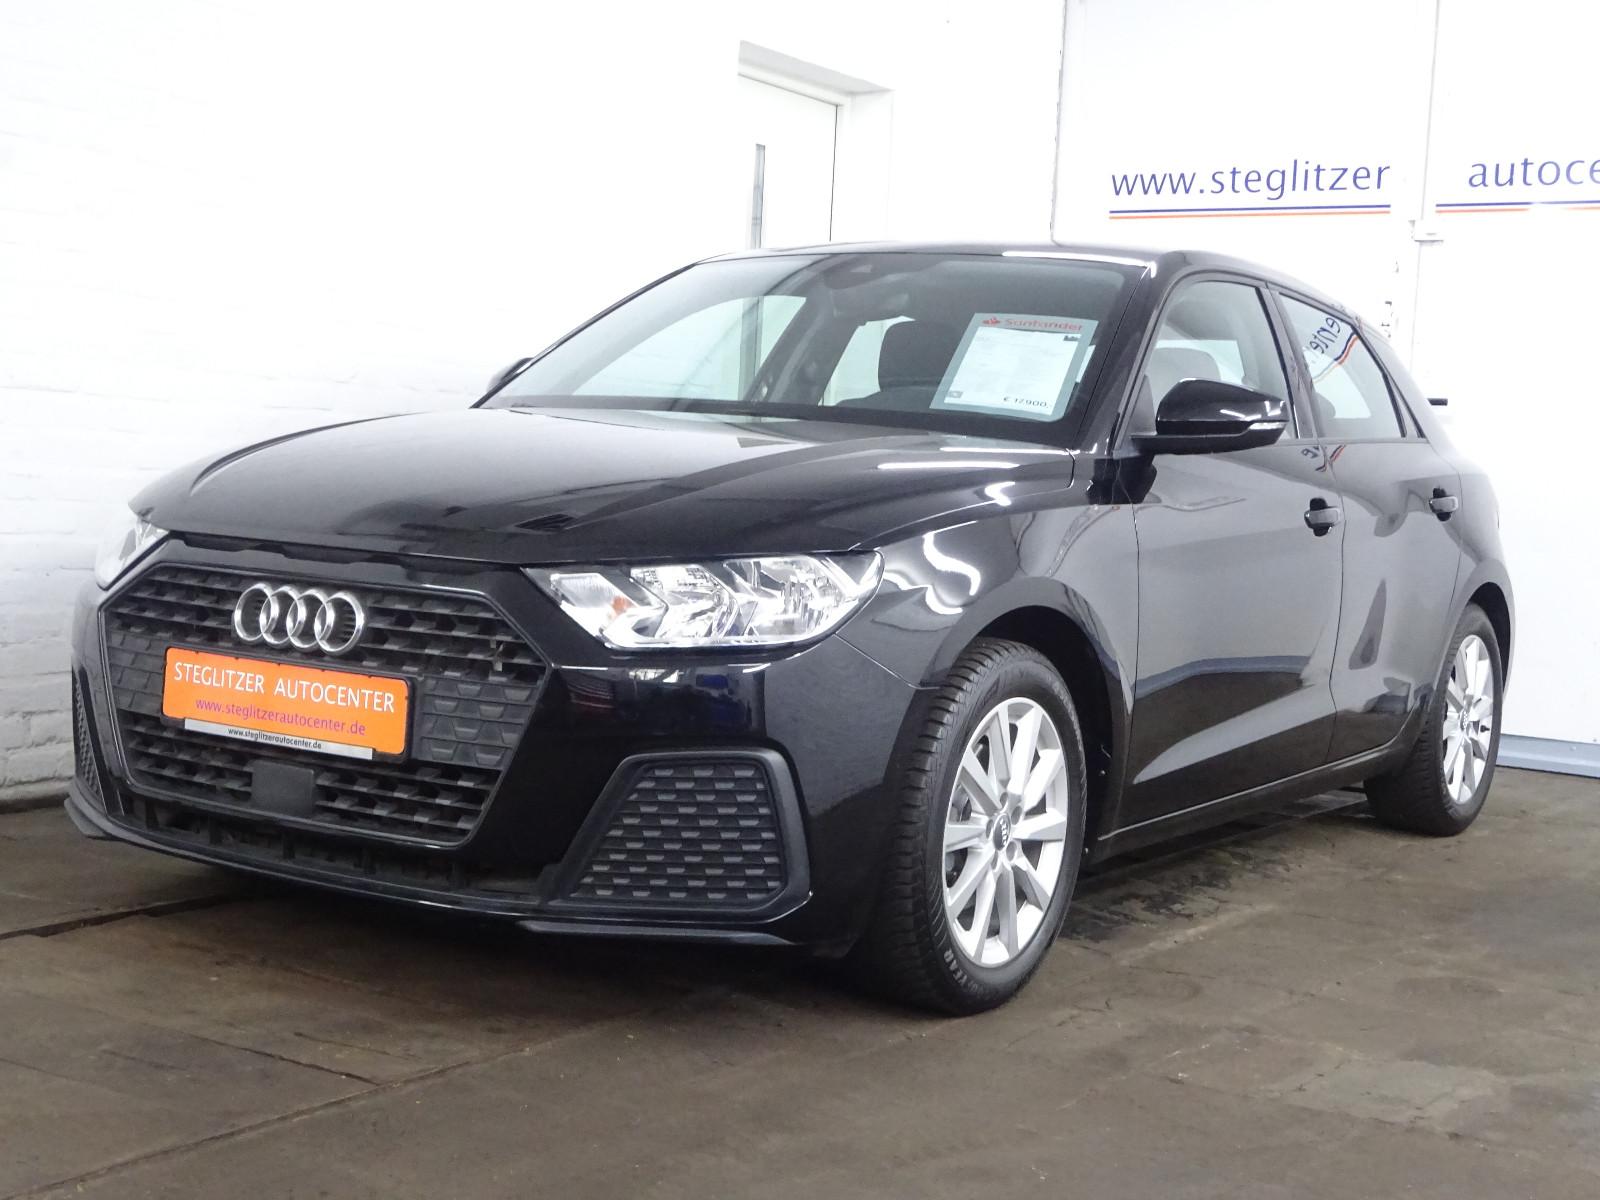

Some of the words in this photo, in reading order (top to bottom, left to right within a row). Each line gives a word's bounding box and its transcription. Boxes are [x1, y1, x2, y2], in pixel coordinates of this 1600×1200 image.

[1111, 159, 1390, 200] www.steglitzer
[1006, 318, 1082, 330] Santander
[174, 661, 265, 694] STEGLITZER
[274, 678, 395, 713] AUTOCENTER
[195, 699, 366, 736] www.steglitzerautocenter.de
[228, 727, 322, 750] www.steglitzerautocenter.de
